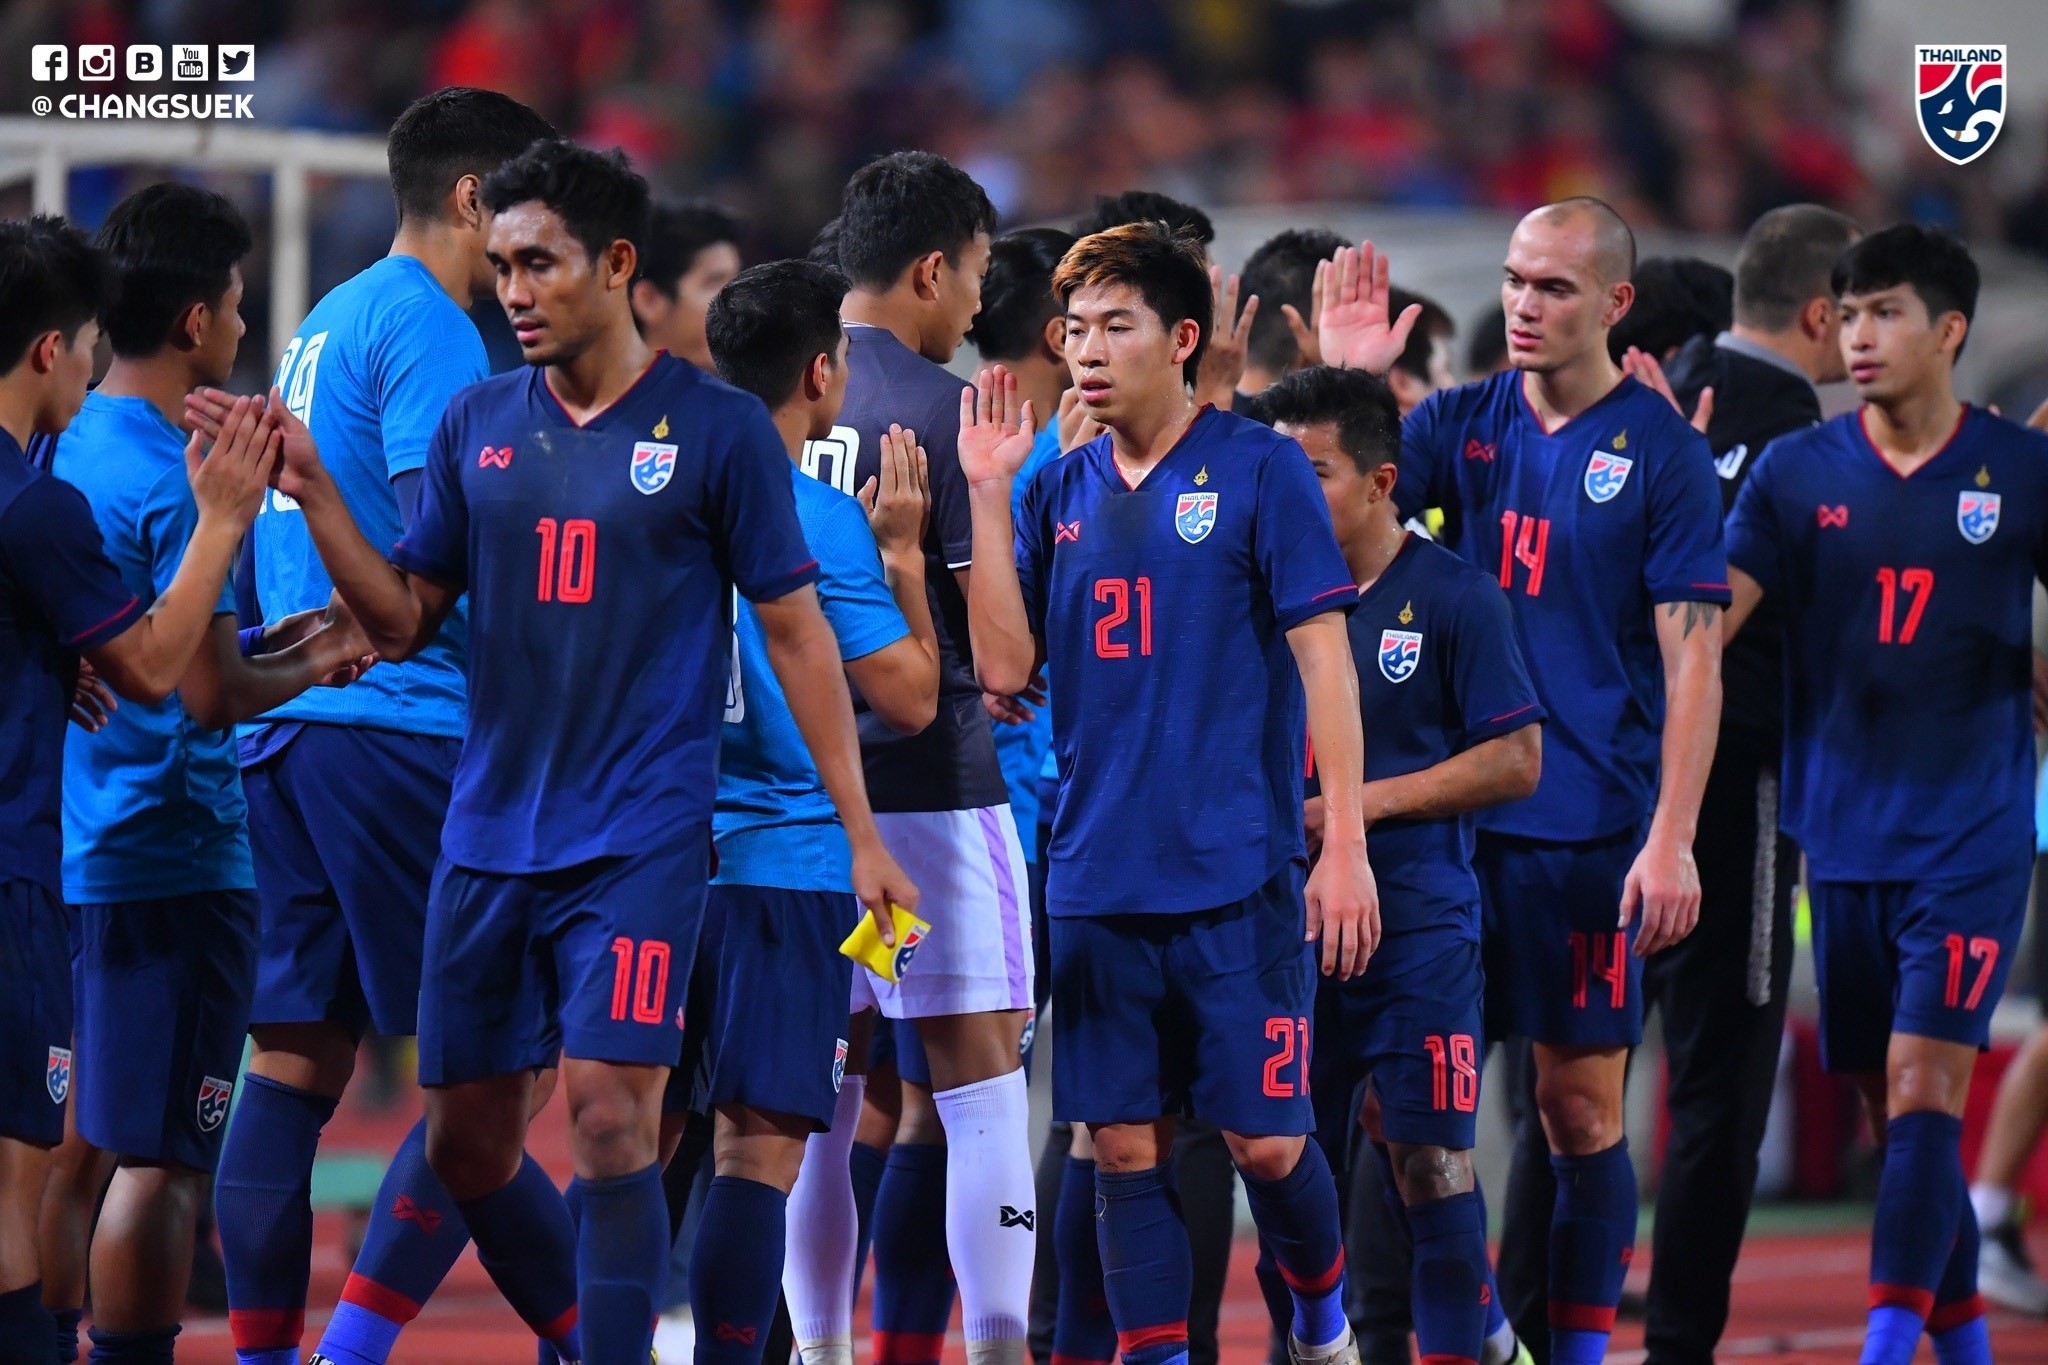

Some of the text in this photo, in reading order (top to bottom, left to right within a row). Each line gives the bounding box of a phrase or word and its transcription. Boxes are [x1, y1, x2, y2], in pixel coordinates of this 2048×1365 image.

[535, 517, 596, 603] 10
[1500, 510, 1550, 596] 14
[1095, 576, 1151, 658] 21
[1876, 567, 1934, 644] 17
[611, 936, 671, 1024] 10
[1567, 931, 1626, 1008] 14
[1944, 934, 2000, 1011] 17
[1263, 1016, 1309, 1097] 21
[1423, 1034, 1477, 1112] 18
